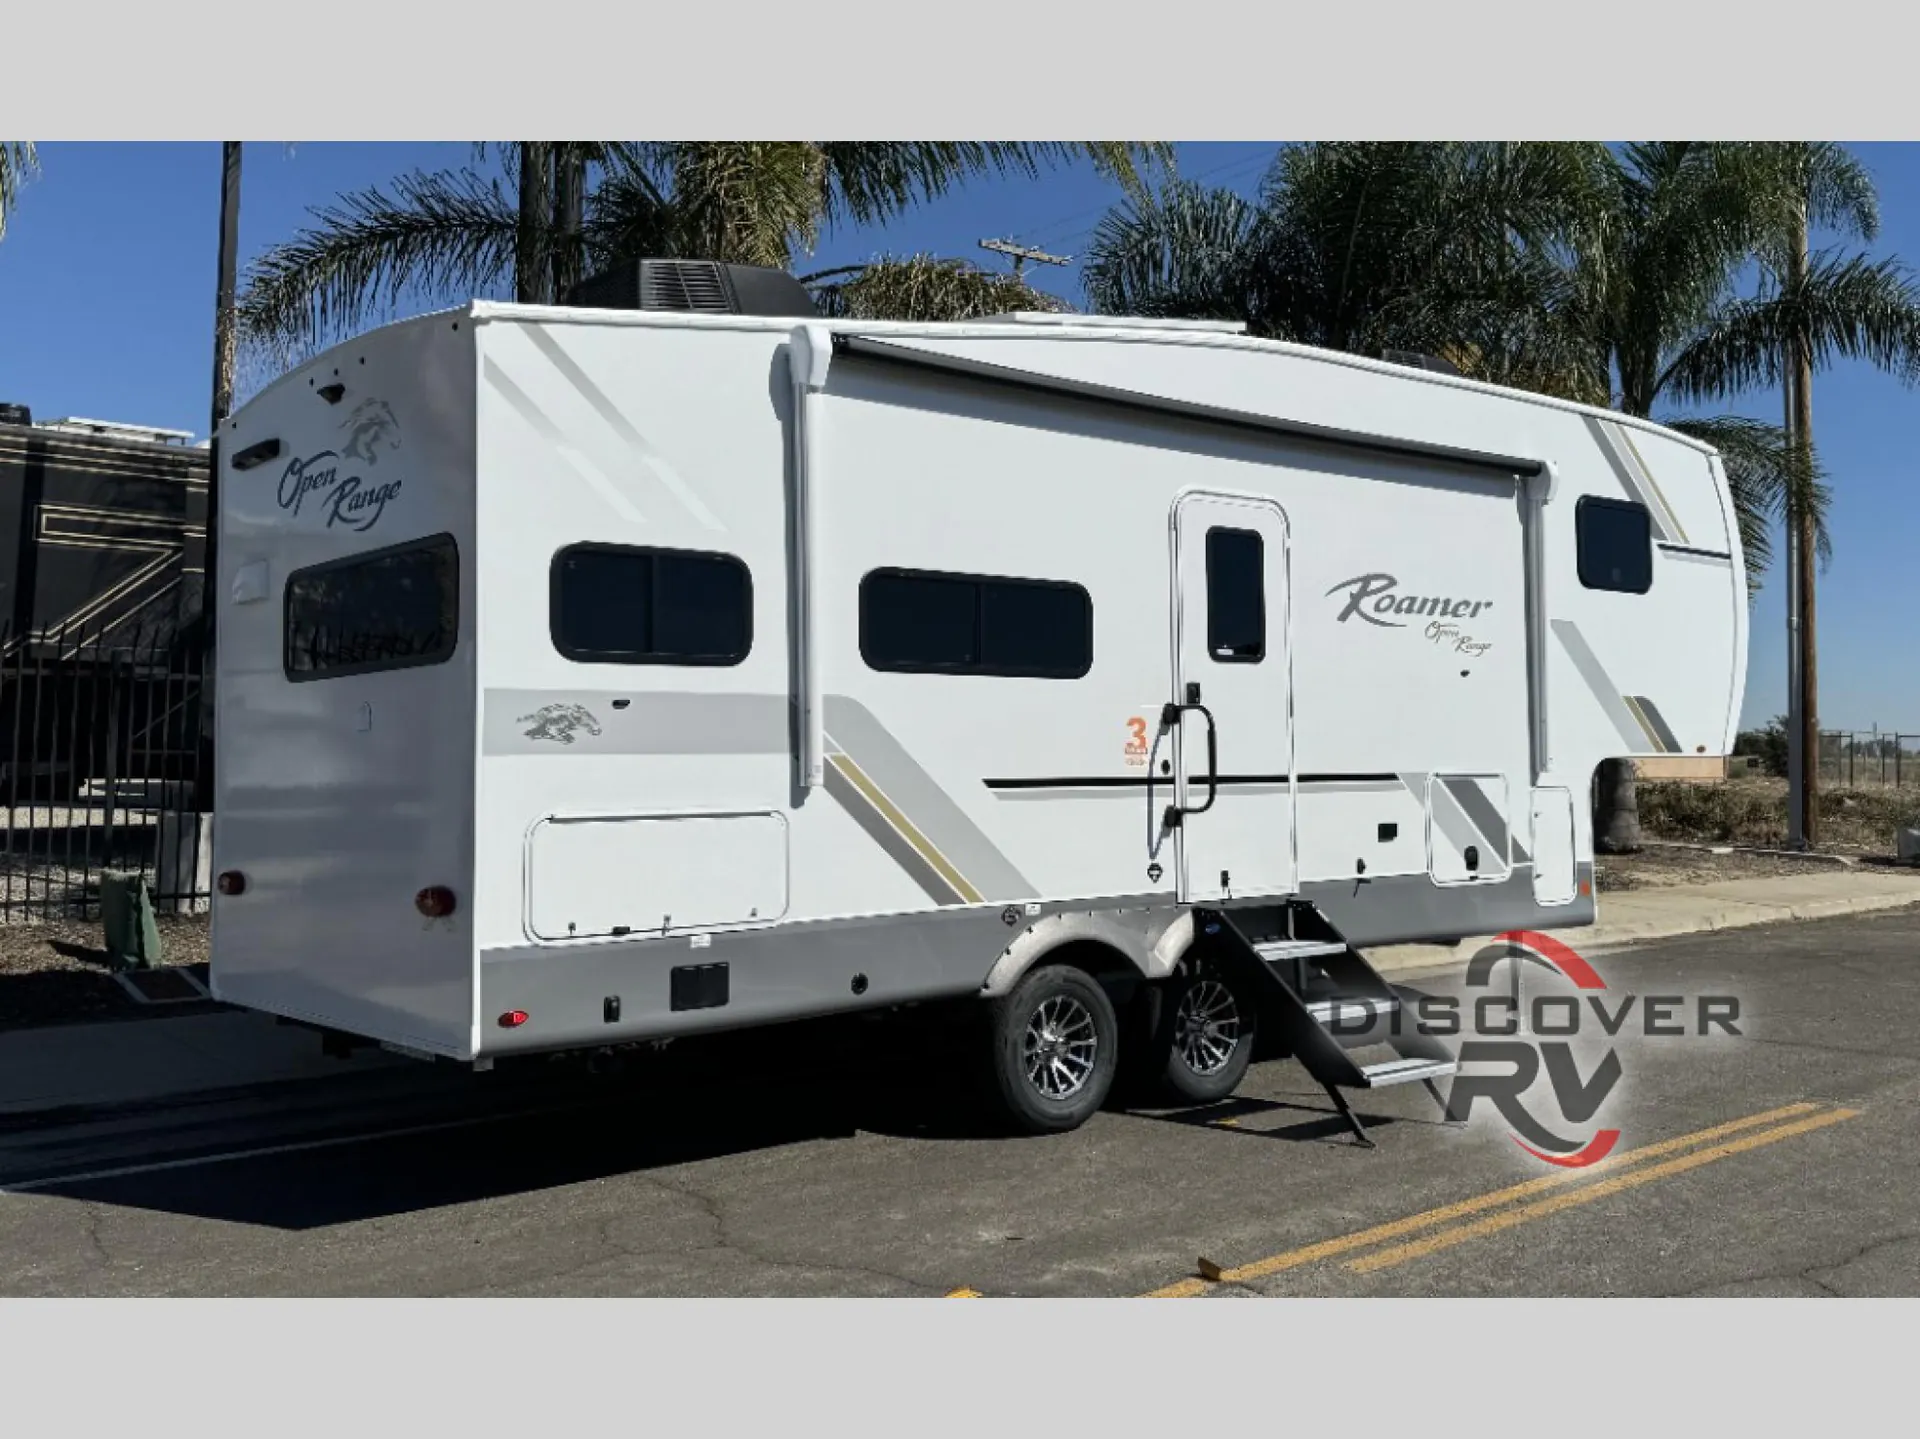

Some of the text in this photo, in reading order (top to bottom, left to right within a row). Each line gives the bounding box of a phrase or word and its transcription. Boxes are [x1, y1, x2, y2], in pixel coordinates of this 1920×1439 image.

[277, 450, 340, 518] Open
[321, 476, 402, 532] Range
[1324, 572, 1494, 628] Roamer
[1424, 620, 1460, 644] Open
[1451, 635, 1492, 658] Range
